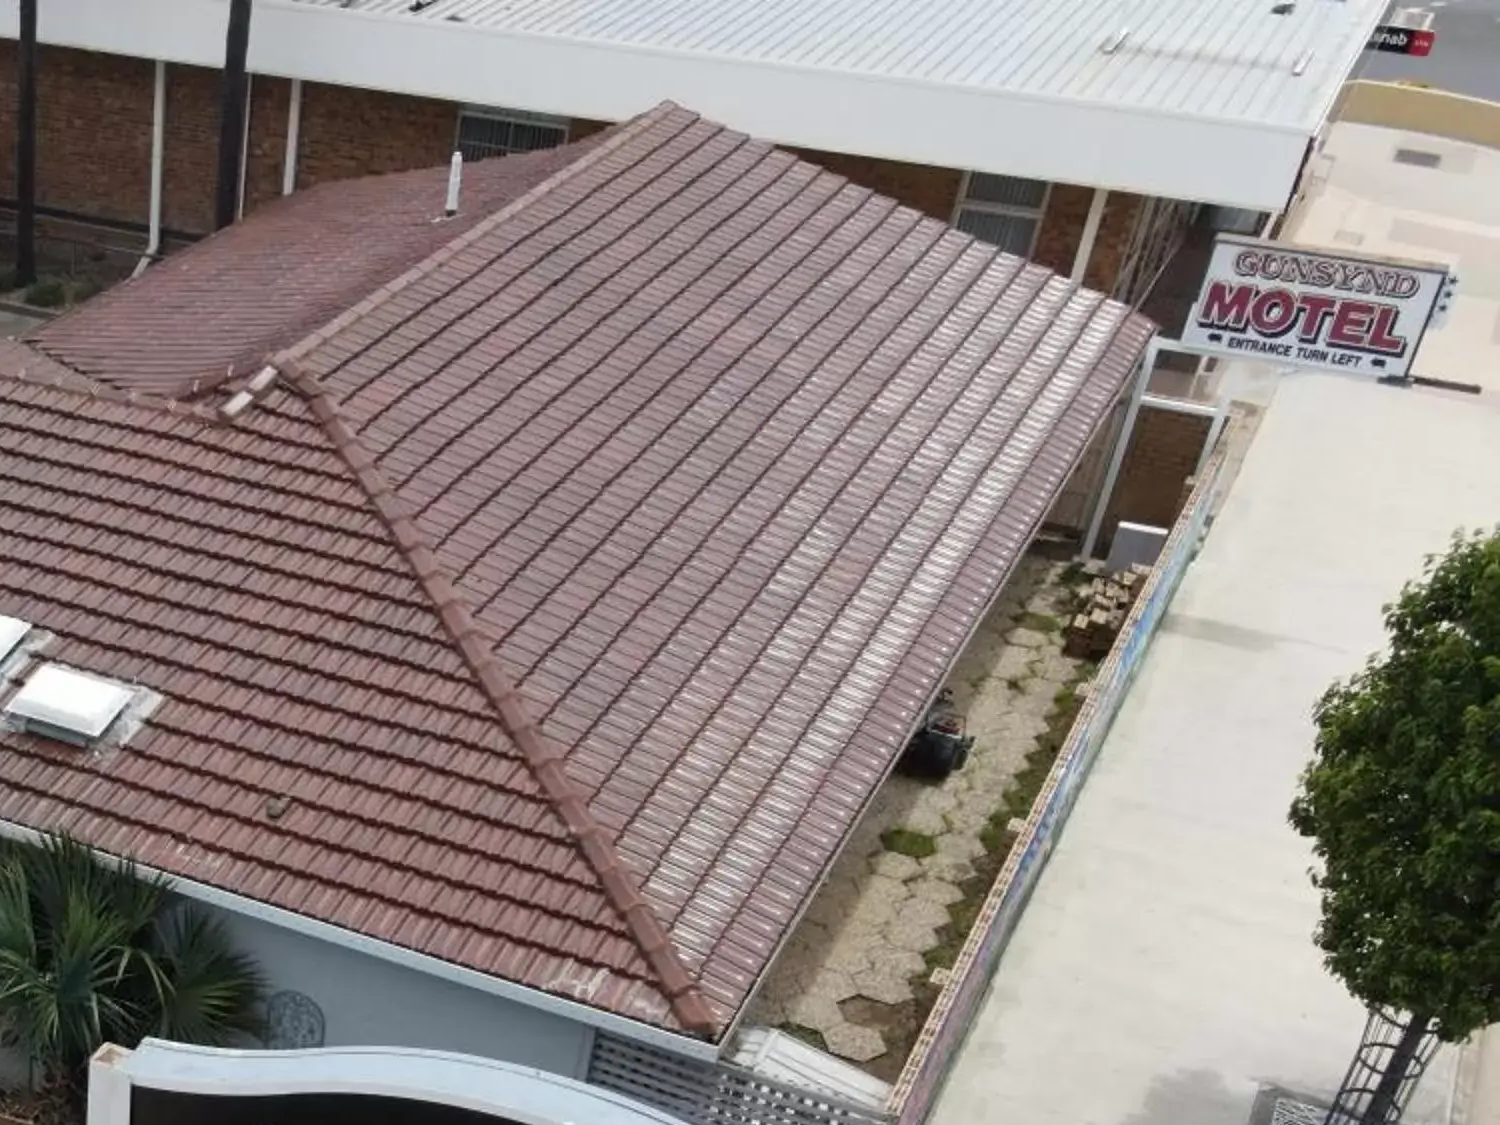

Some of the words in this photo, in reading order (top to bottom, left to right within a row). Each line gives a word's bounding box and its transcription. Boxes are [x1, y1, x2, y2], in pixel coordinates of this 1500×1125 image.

[1233, 251, 1421, 298] GUNSYND
[1197, 281, 1407, 356] MOTEL
[1228, 336, 1292, 357] ENTRANCE
[1297, 345, 1328, 363] TURN
[1332, 352, 1363, 367] LEFT
